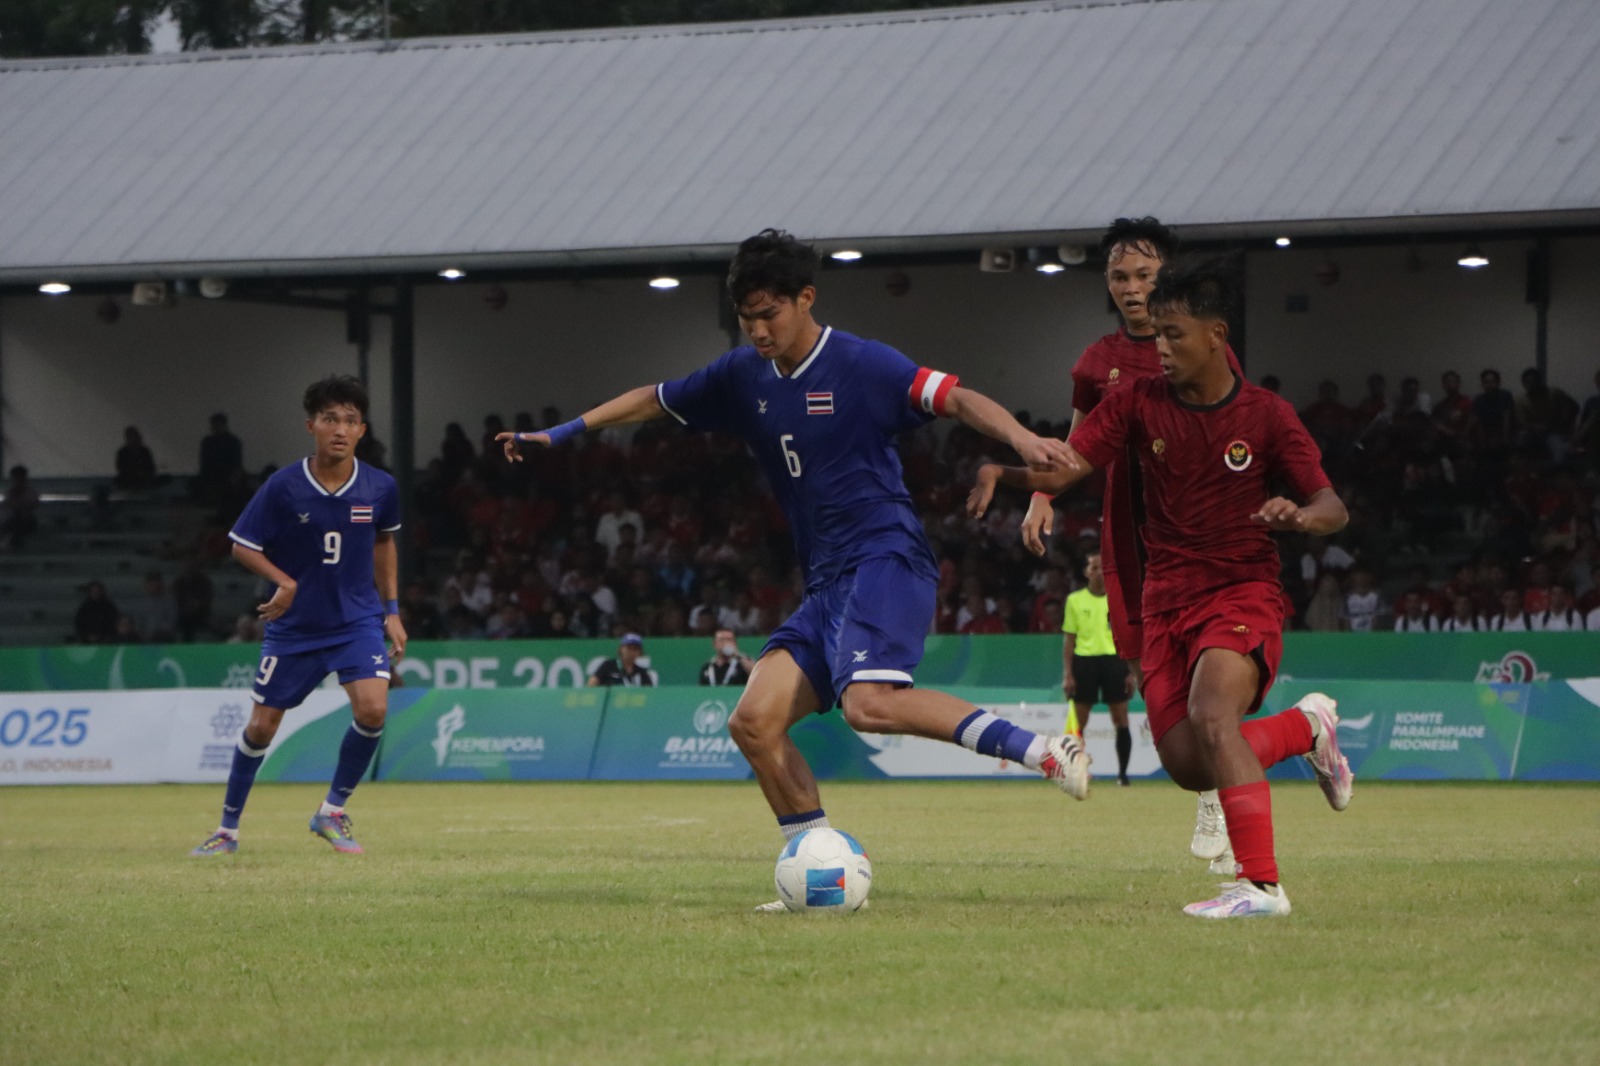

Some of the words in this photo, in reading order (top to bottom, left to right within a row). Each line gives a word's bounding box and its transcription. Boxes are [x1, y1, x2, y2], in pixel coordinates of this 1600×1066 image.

[780, 434, 802, 478] 6
[322, 531, 342, 565] 9
[255, 655, 278, 686] 9
[1395, 711, 1444, 724] KOMITE
[1389, 739, 1459, 751] INDONESIA
[23, 758, 113, 773] INDONESIA
